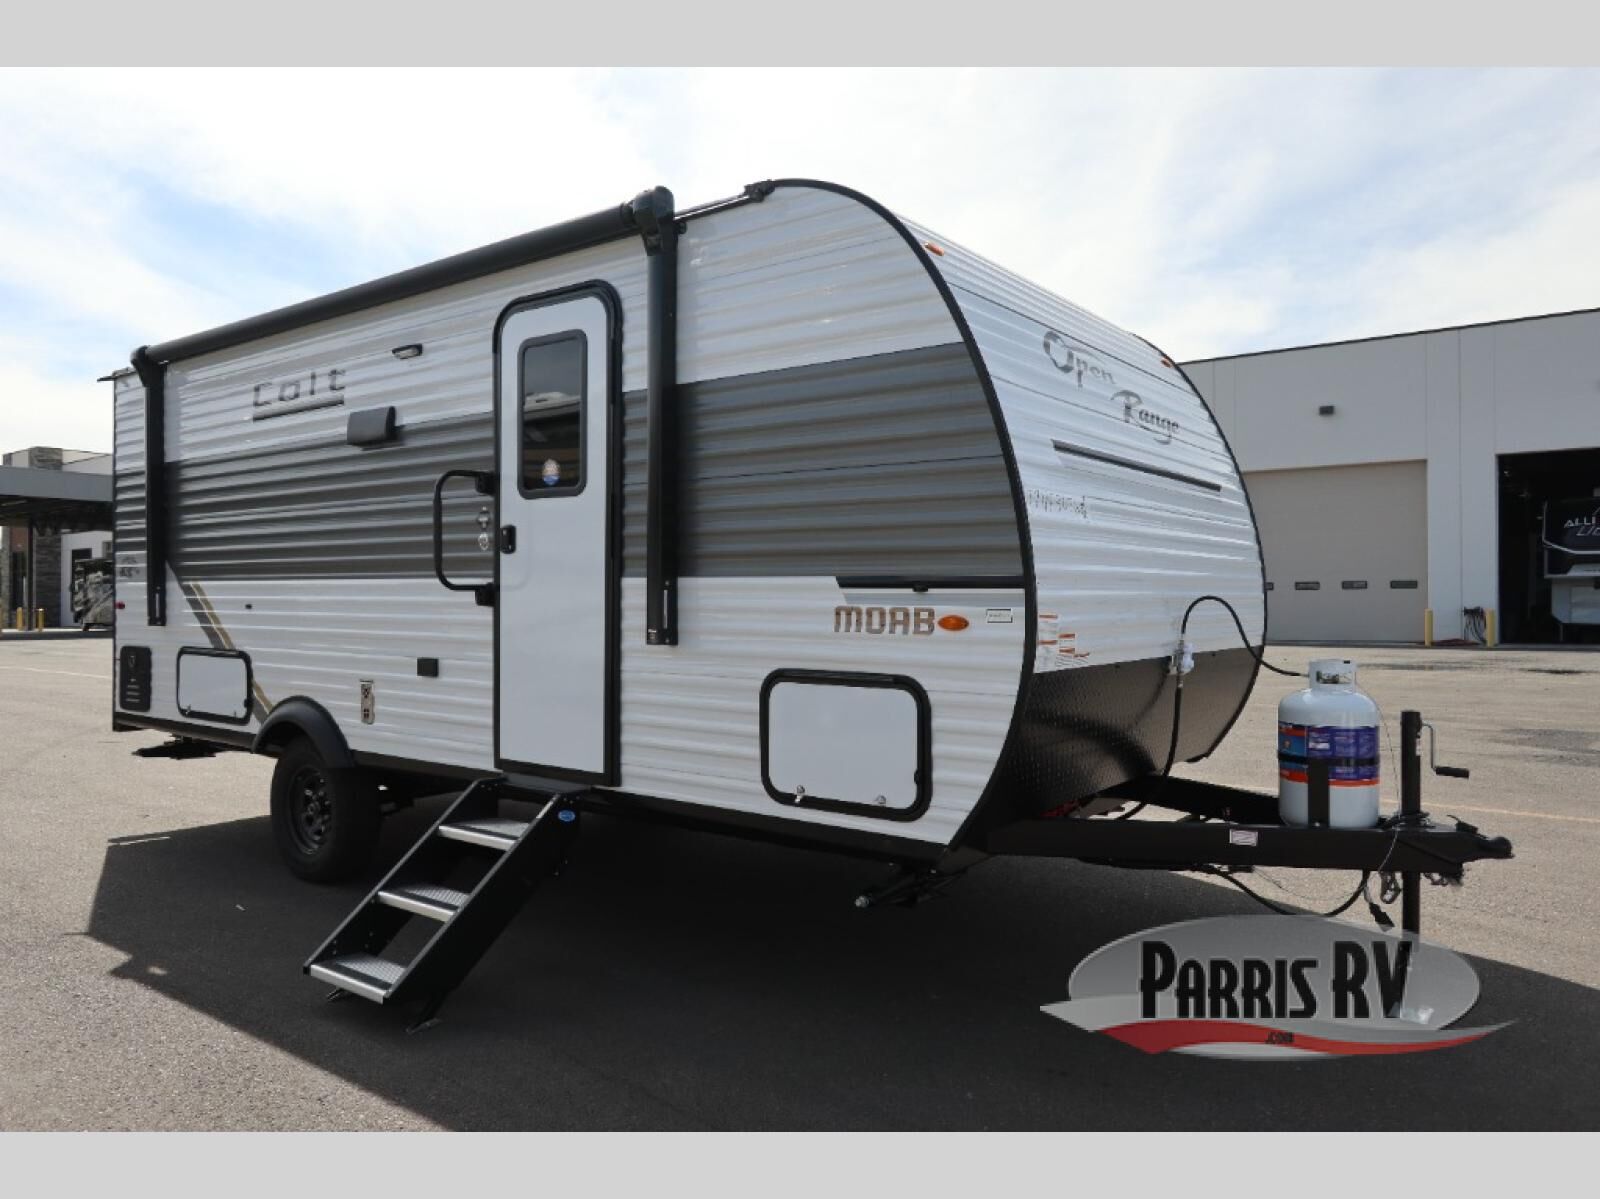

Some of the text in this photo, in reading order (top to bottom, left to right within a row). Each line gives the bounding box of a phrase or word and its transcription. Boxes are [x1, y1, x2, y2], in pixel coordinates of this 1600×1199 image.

[253, 369, 346, 407] Colt
[1043, 331, 1181, 445] Open Range
[834, 605, 935, 635] MOAB
